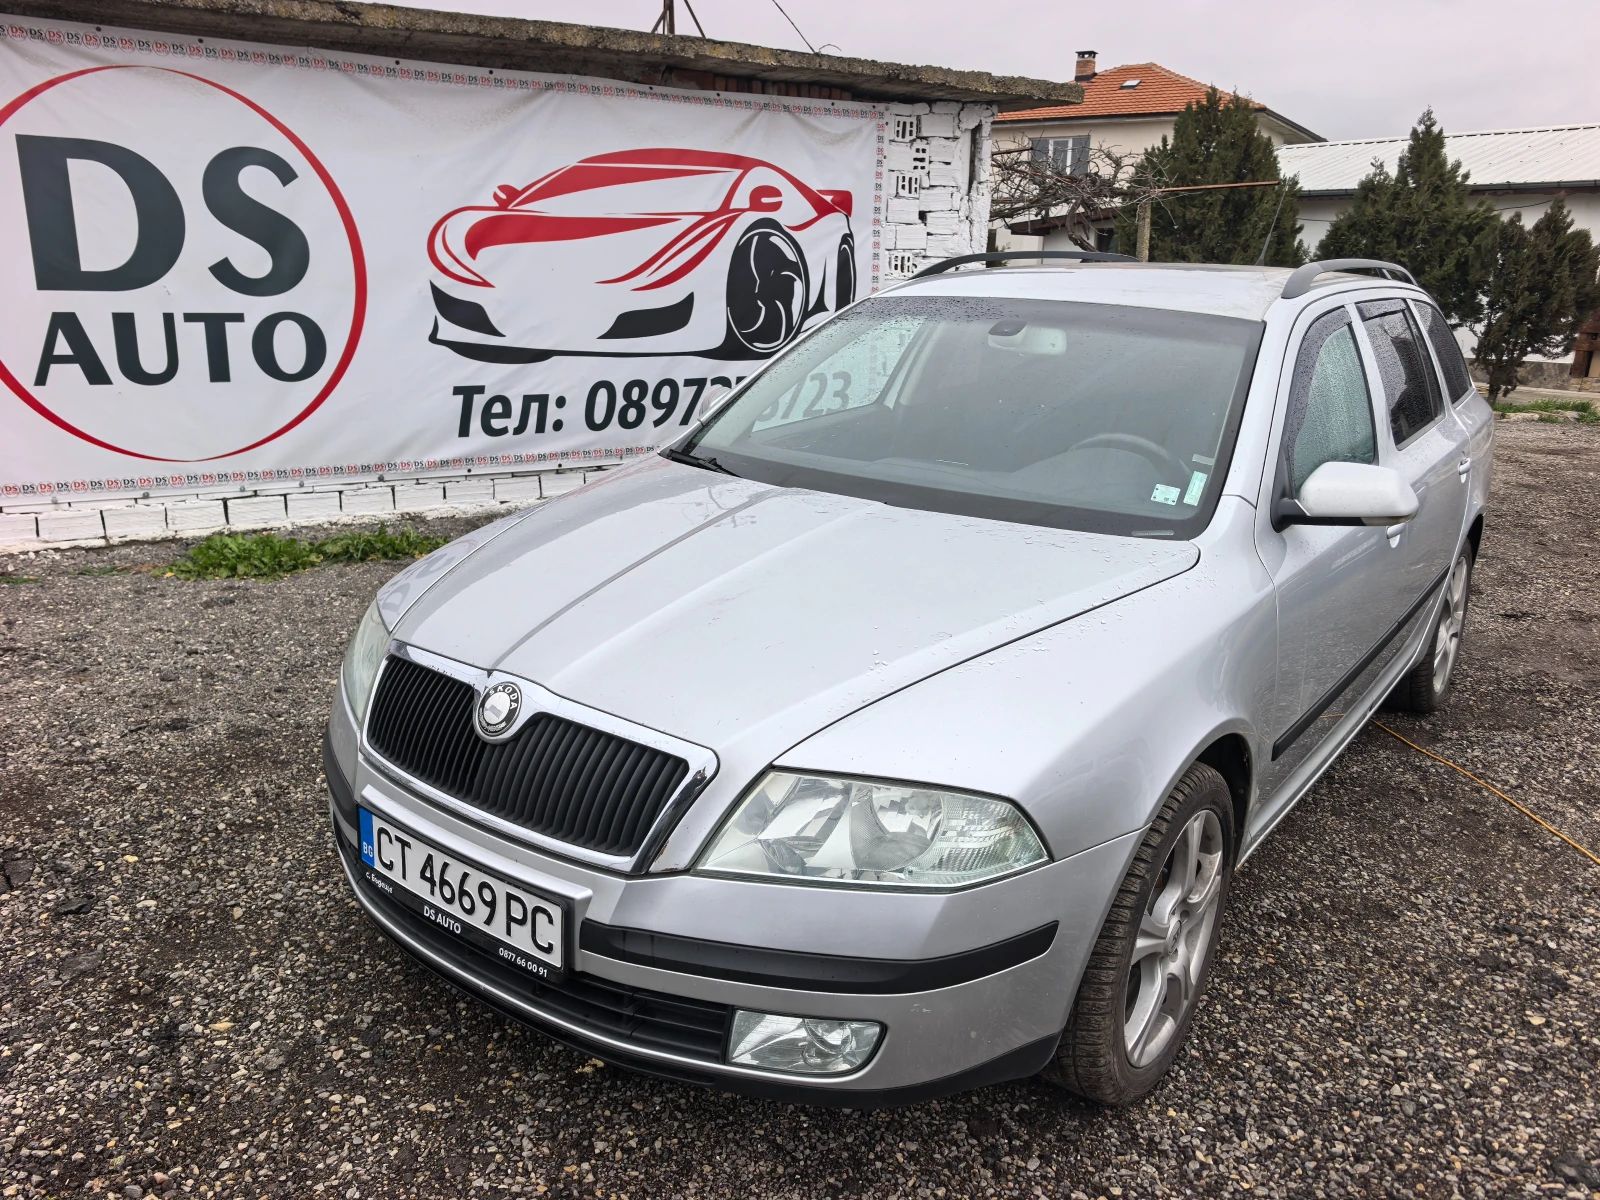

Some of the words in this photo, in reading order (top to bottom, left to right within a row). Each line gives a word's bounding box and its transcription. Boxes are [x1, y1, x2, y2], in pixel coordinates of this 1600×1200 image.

[66, 32, 80, 40] DS
[205, 47, 217, 55] DS
[221, 48, 233, 56] DS
[236, 50, 248, 58] DS
[15, 134, 310, 297] DS
[34, 311, 328, 387] AUTO
[452, 384, 567, 438] Тел:
[363, 841, 373, 858] BG
[377, 826, 411, 881] CT
[420, 852, 497, 926] 4669
[506, 890, 554, 954] PC
[424, 906, 436, 920] DS
[436, 913, 461, 934] AUTO
[499, 948, 515, 962] 0877
[516, 956, 526, 967] 66
[527, 962, 537, 973] 00
[539, 967, 548, 977] 91
